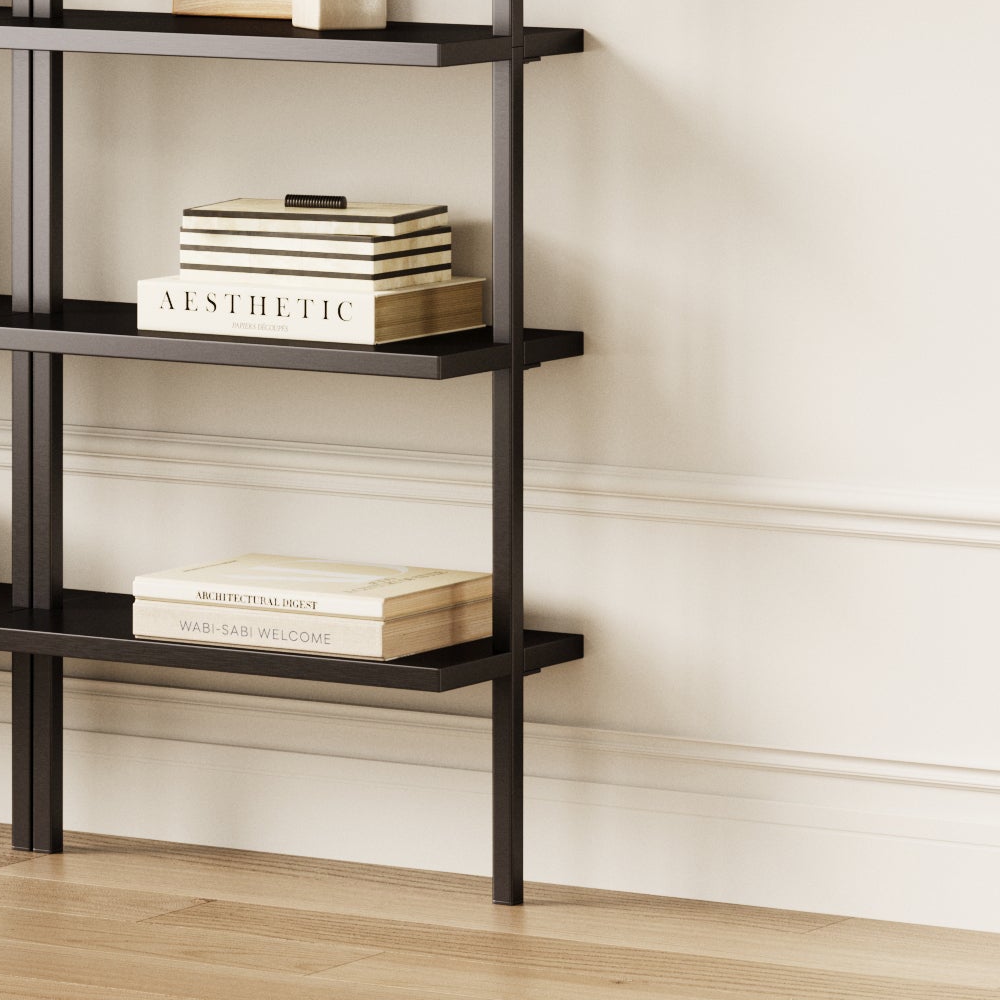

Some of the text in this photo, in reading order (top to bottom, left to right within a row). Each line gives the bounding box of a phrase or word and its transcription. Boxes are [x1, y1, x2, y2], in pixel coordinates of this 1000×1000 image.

[160, 290, 353, 322] AESTHETIC
[196, 591, 318, 610] ARCHITECTURAL DIGEST
[179, 619, 332, 645] WABI-SABI WELCOME
